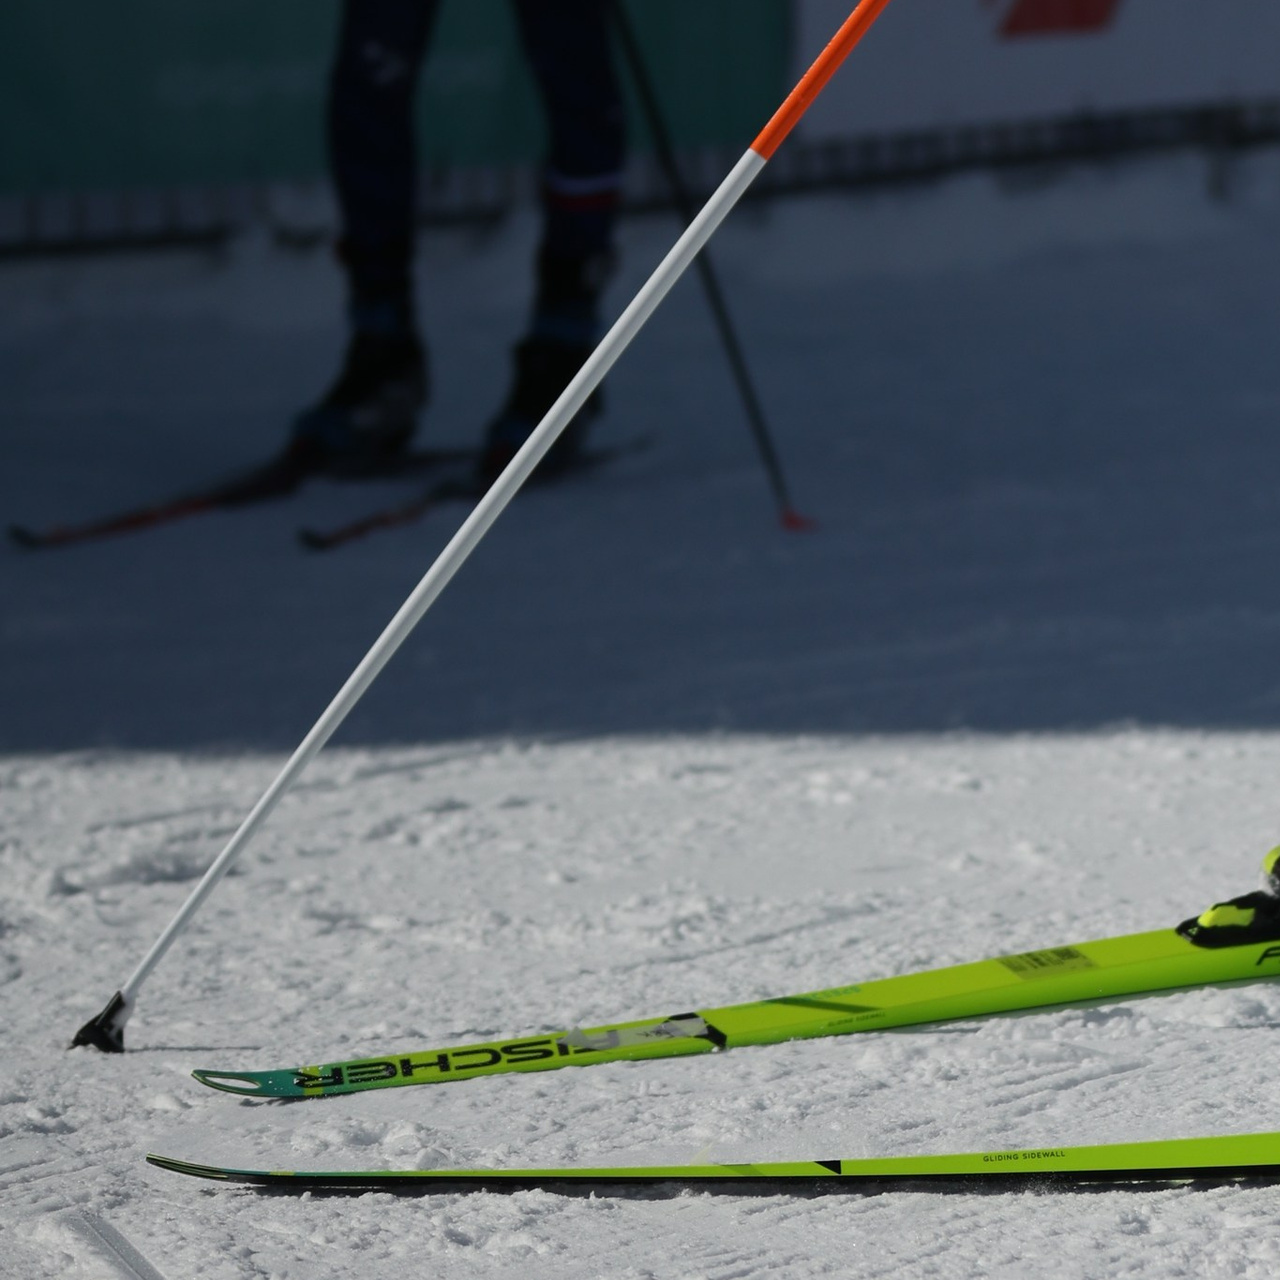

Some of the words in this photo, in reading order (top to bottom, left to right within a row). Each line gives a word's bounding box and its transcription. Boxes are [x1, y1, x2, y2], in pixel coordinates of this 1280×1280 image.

[294, 1028, 622, 1089] FISCHER
[982, 1153, 1020, 1163] GLIDING
[1021, 1150, 1067, 1160] SIDEWALL
